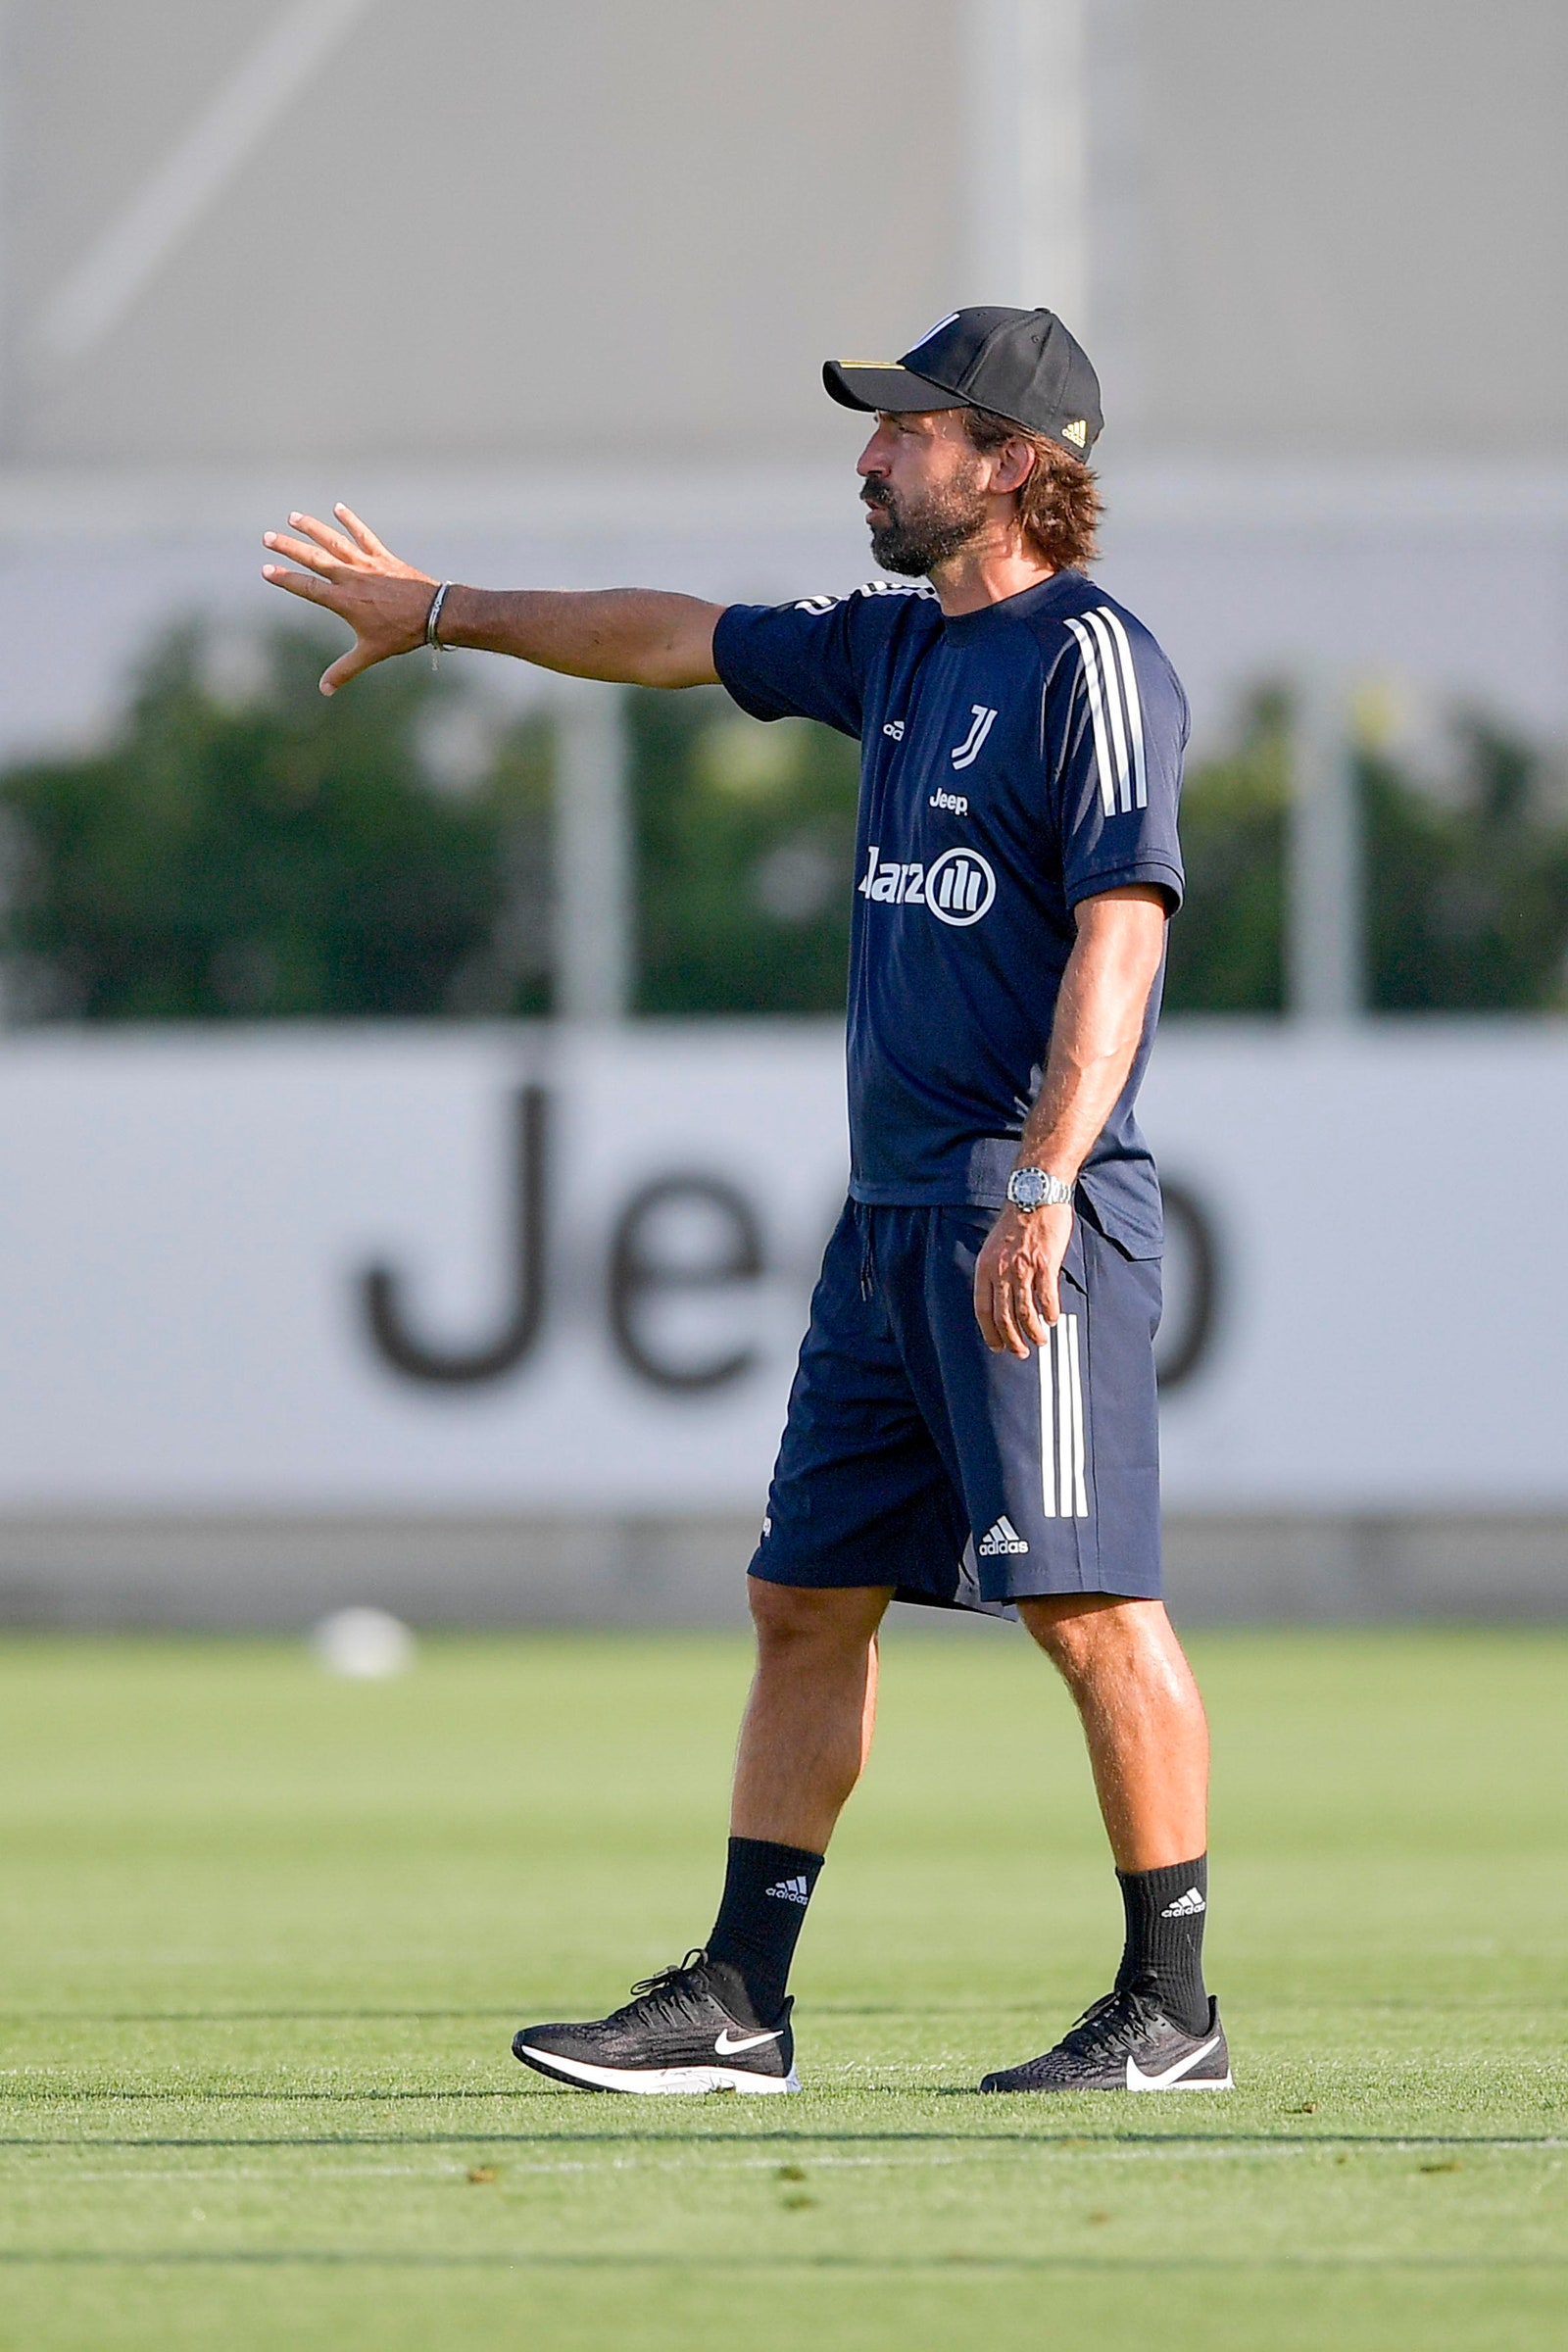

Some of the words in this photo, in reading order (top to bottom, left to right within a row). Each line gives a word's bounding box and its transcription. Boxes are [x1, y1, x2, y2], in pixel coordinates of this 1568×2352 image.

[979, 1540, 1029, 1556] adidas
[765, 1887, 808, 1905] adidas
[1160, 1901, 1205, 1918] adidas
